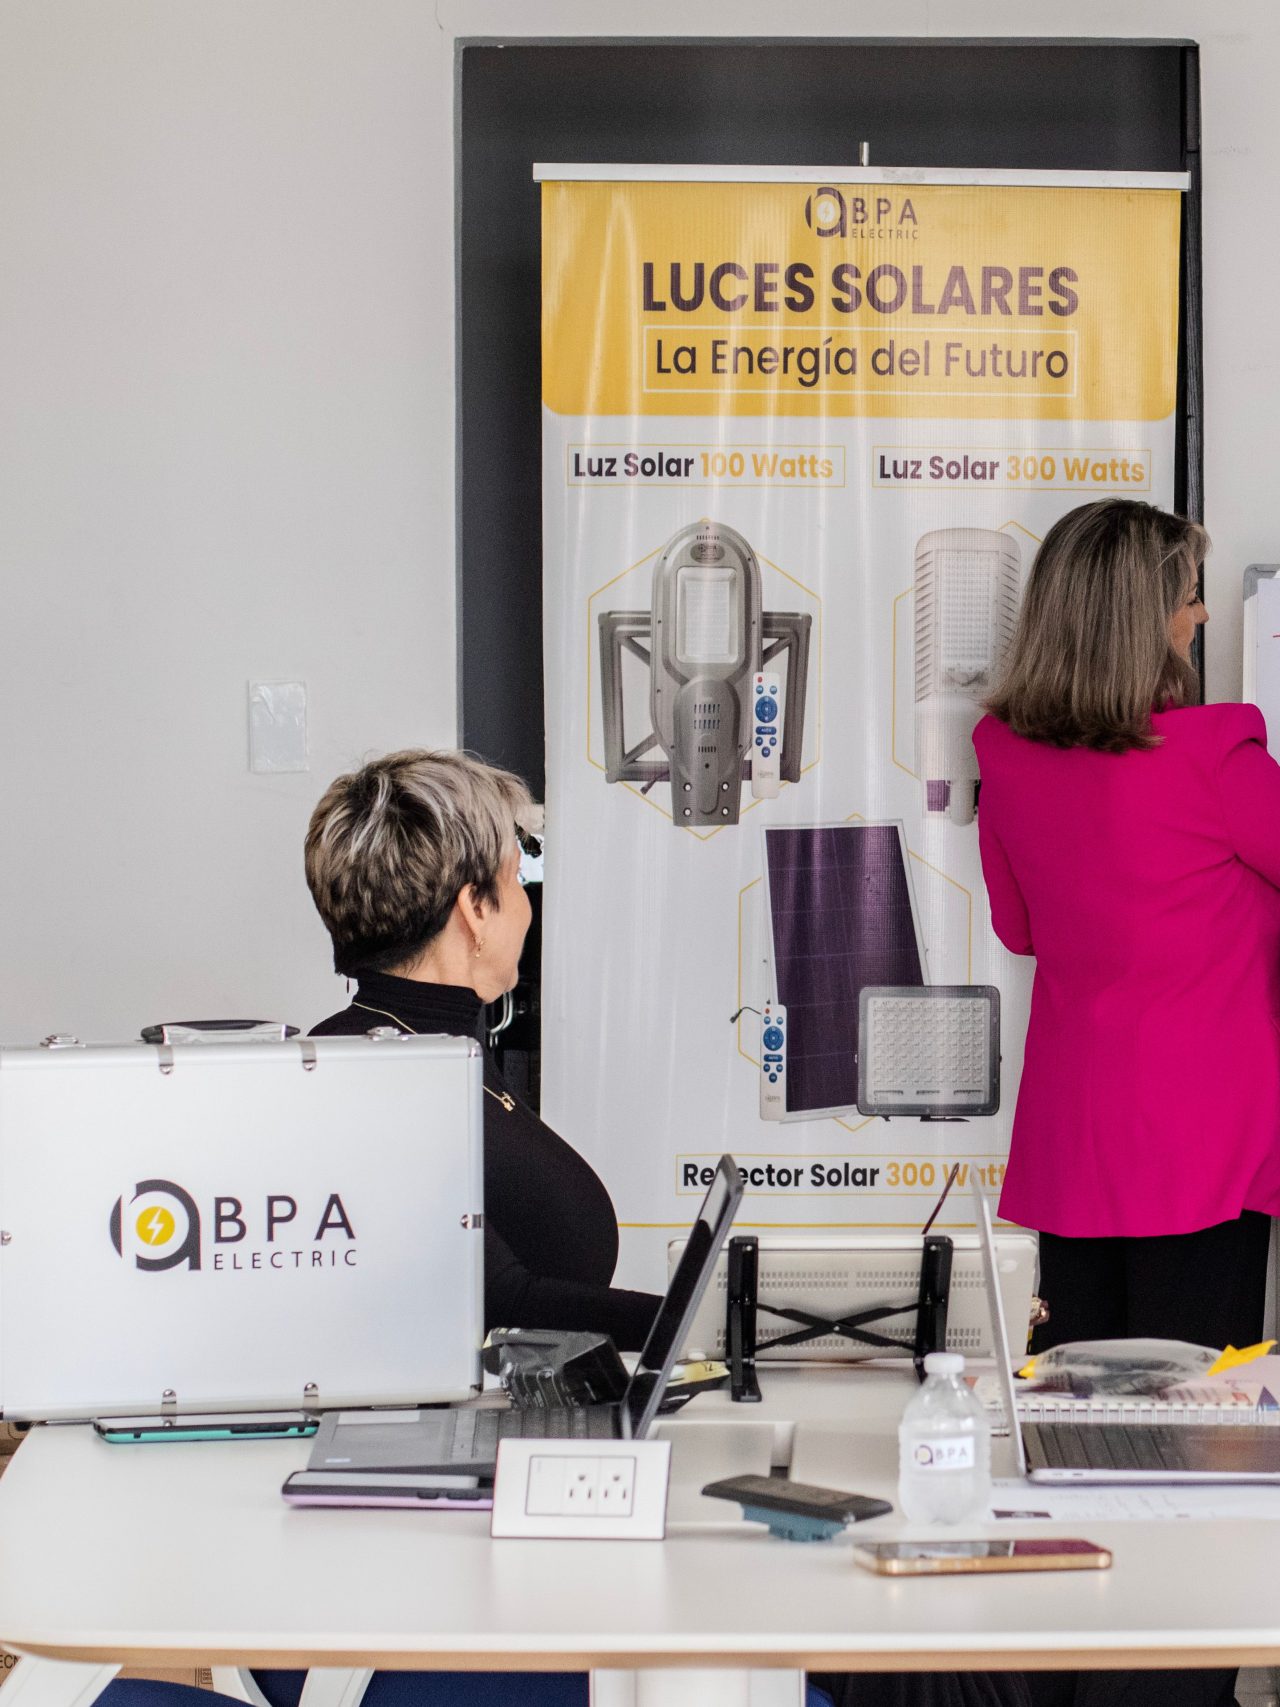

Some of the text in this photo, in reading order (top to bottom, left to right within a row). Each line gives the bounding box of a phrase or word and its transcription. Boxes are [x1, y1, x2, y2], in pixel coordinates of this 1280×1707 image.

[852, 197, 918, 226] BPA
[851, 227, 919, 241] ELECTRIC
[642, 261, 1079, 317] LUCES SOLARES
[656, 335, 1069, 388] La Energía del Futuro
[573, 452, 834, 480] Luz Solar 100 Watts
[878, 454, 1145, 484] Luz Solar 300 Watts
[683, 1162, 1006, 1188] Reector Solar 300 Wtt
[213, 1192, 356, 1244] BPA
[213, 1248, 358, 1271] ELECTRIC
